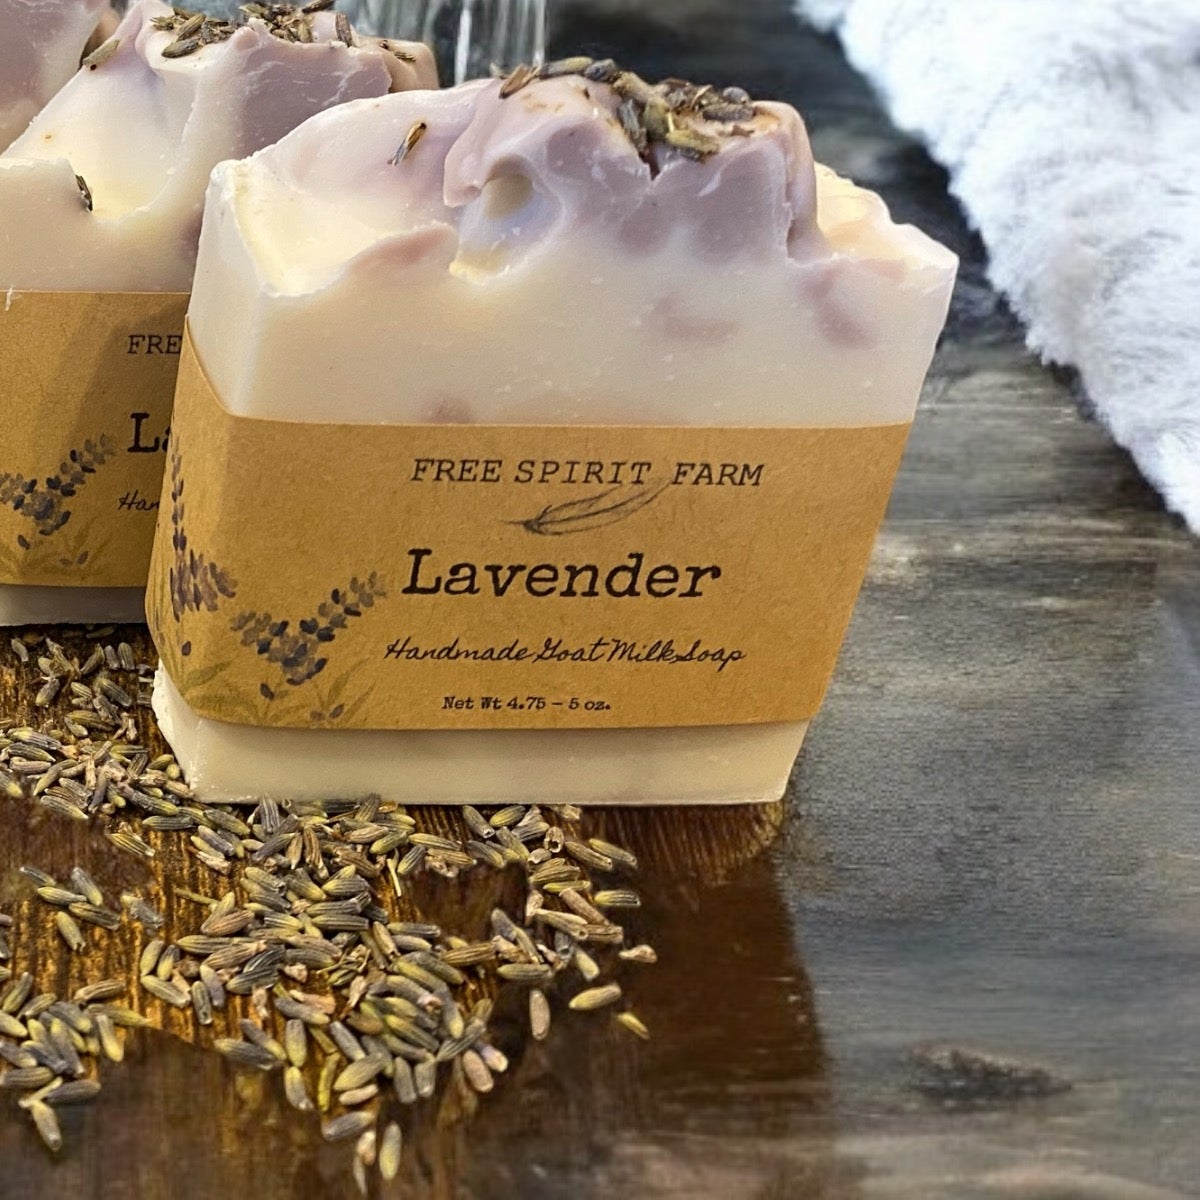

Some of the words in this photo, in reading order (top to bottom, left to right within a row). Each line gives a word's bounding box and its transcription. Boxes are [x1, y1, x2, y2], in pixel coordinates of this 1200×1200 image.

[127, 334, 183, 355] FRE
[410, 459, 503, 483] FREE
[513, 460, 652, 485] SPIRIT
[671, 463, 764, 487] FARM
[402, 549, 722, 598] Lavender
[383, 637, 533, 661] Handmade
[532, 638, 608, 663] Goat
[606, 639, 678, 663] Milk
[669, 640, 747, 672] Soap
[441, 696, 474, 710] Net
[480, 696, 502, 710] Wt
[506, 696, 546, 711] 4.75
[568, 698, 580, 711] 5
[584, 700, 612, 712] oz.
